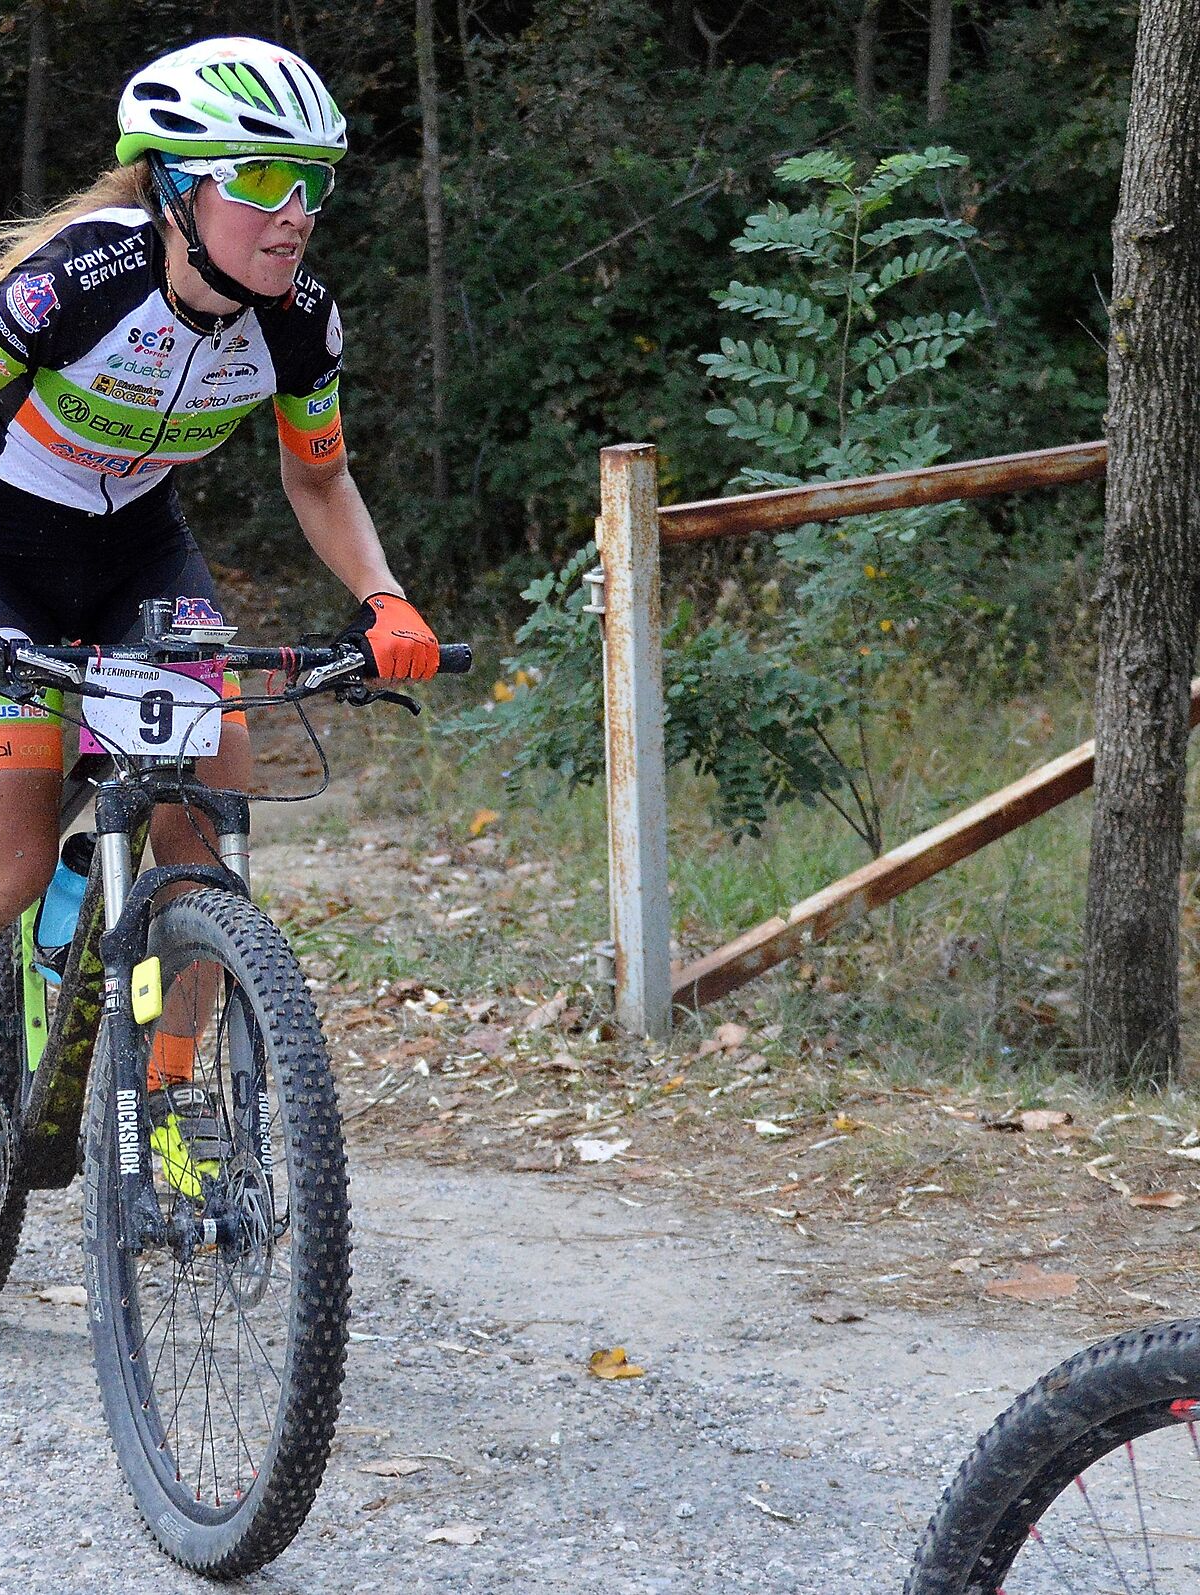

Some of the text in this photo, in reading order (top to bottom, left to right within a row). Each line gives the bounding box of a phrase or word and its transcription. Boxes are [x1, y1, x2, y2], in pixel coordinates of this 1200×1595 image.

[63, 232, 145, 277] FORK LIFT
[80, 251, 147, 290] SERVICE
[295, 270, 326, 300] LIFT
[128, 327, 176, 352] SCA
[88, 414, 180, 443] BOILER
[139, 690, 174, 745] 9
[117, 1090, 140, 1175] ROCKSHOX
